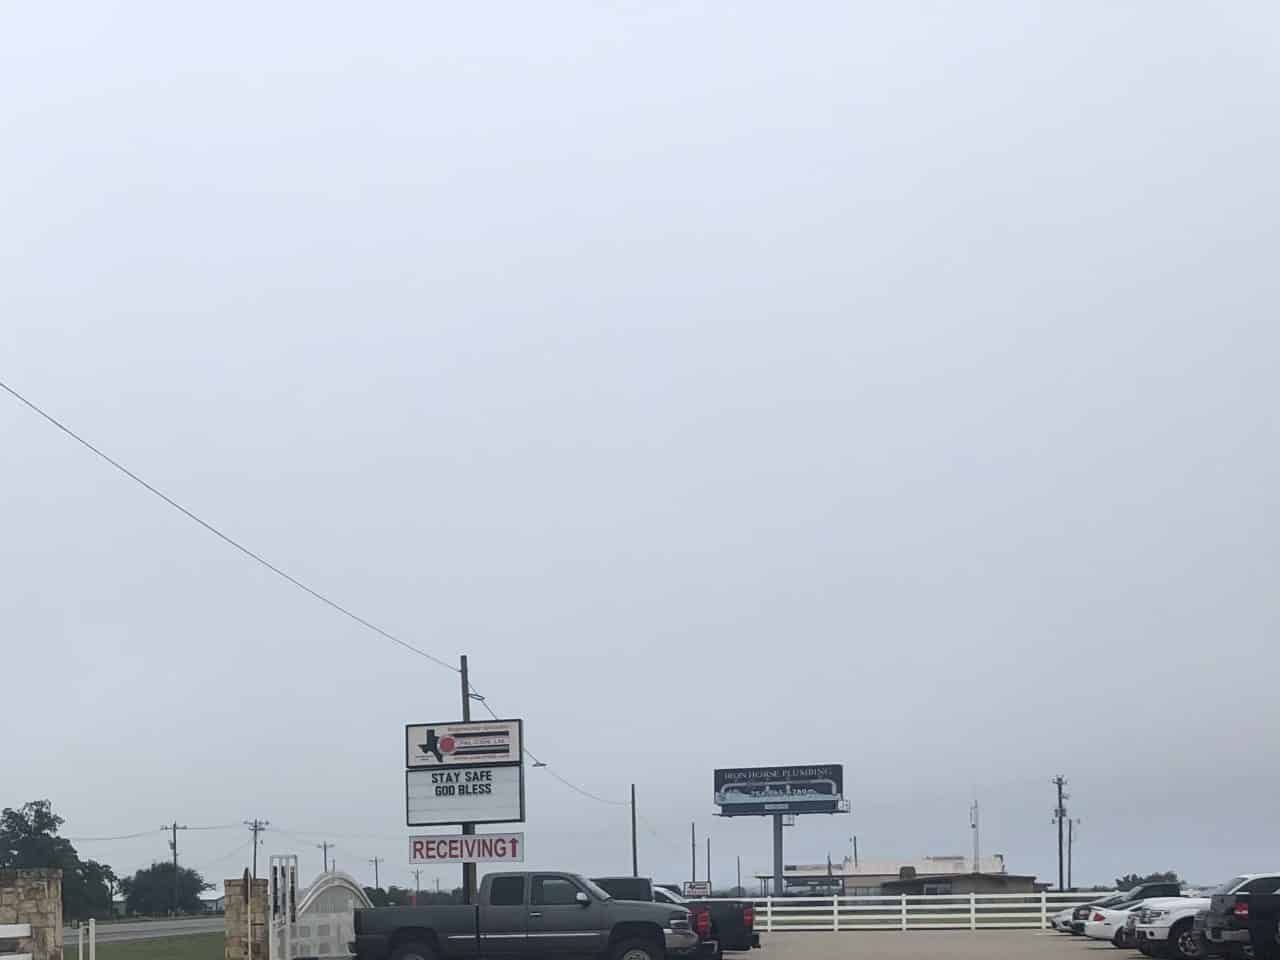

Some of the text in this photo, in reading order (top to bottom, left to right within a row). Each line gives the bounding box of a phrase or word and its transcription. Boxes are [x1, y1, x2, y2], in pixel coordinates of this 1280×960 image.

[431, 770, 493, 784] STAY SAFE
[435, 783, 492, 797] GOD BLESS
[412, 838, 507, 859] RECEIVING
